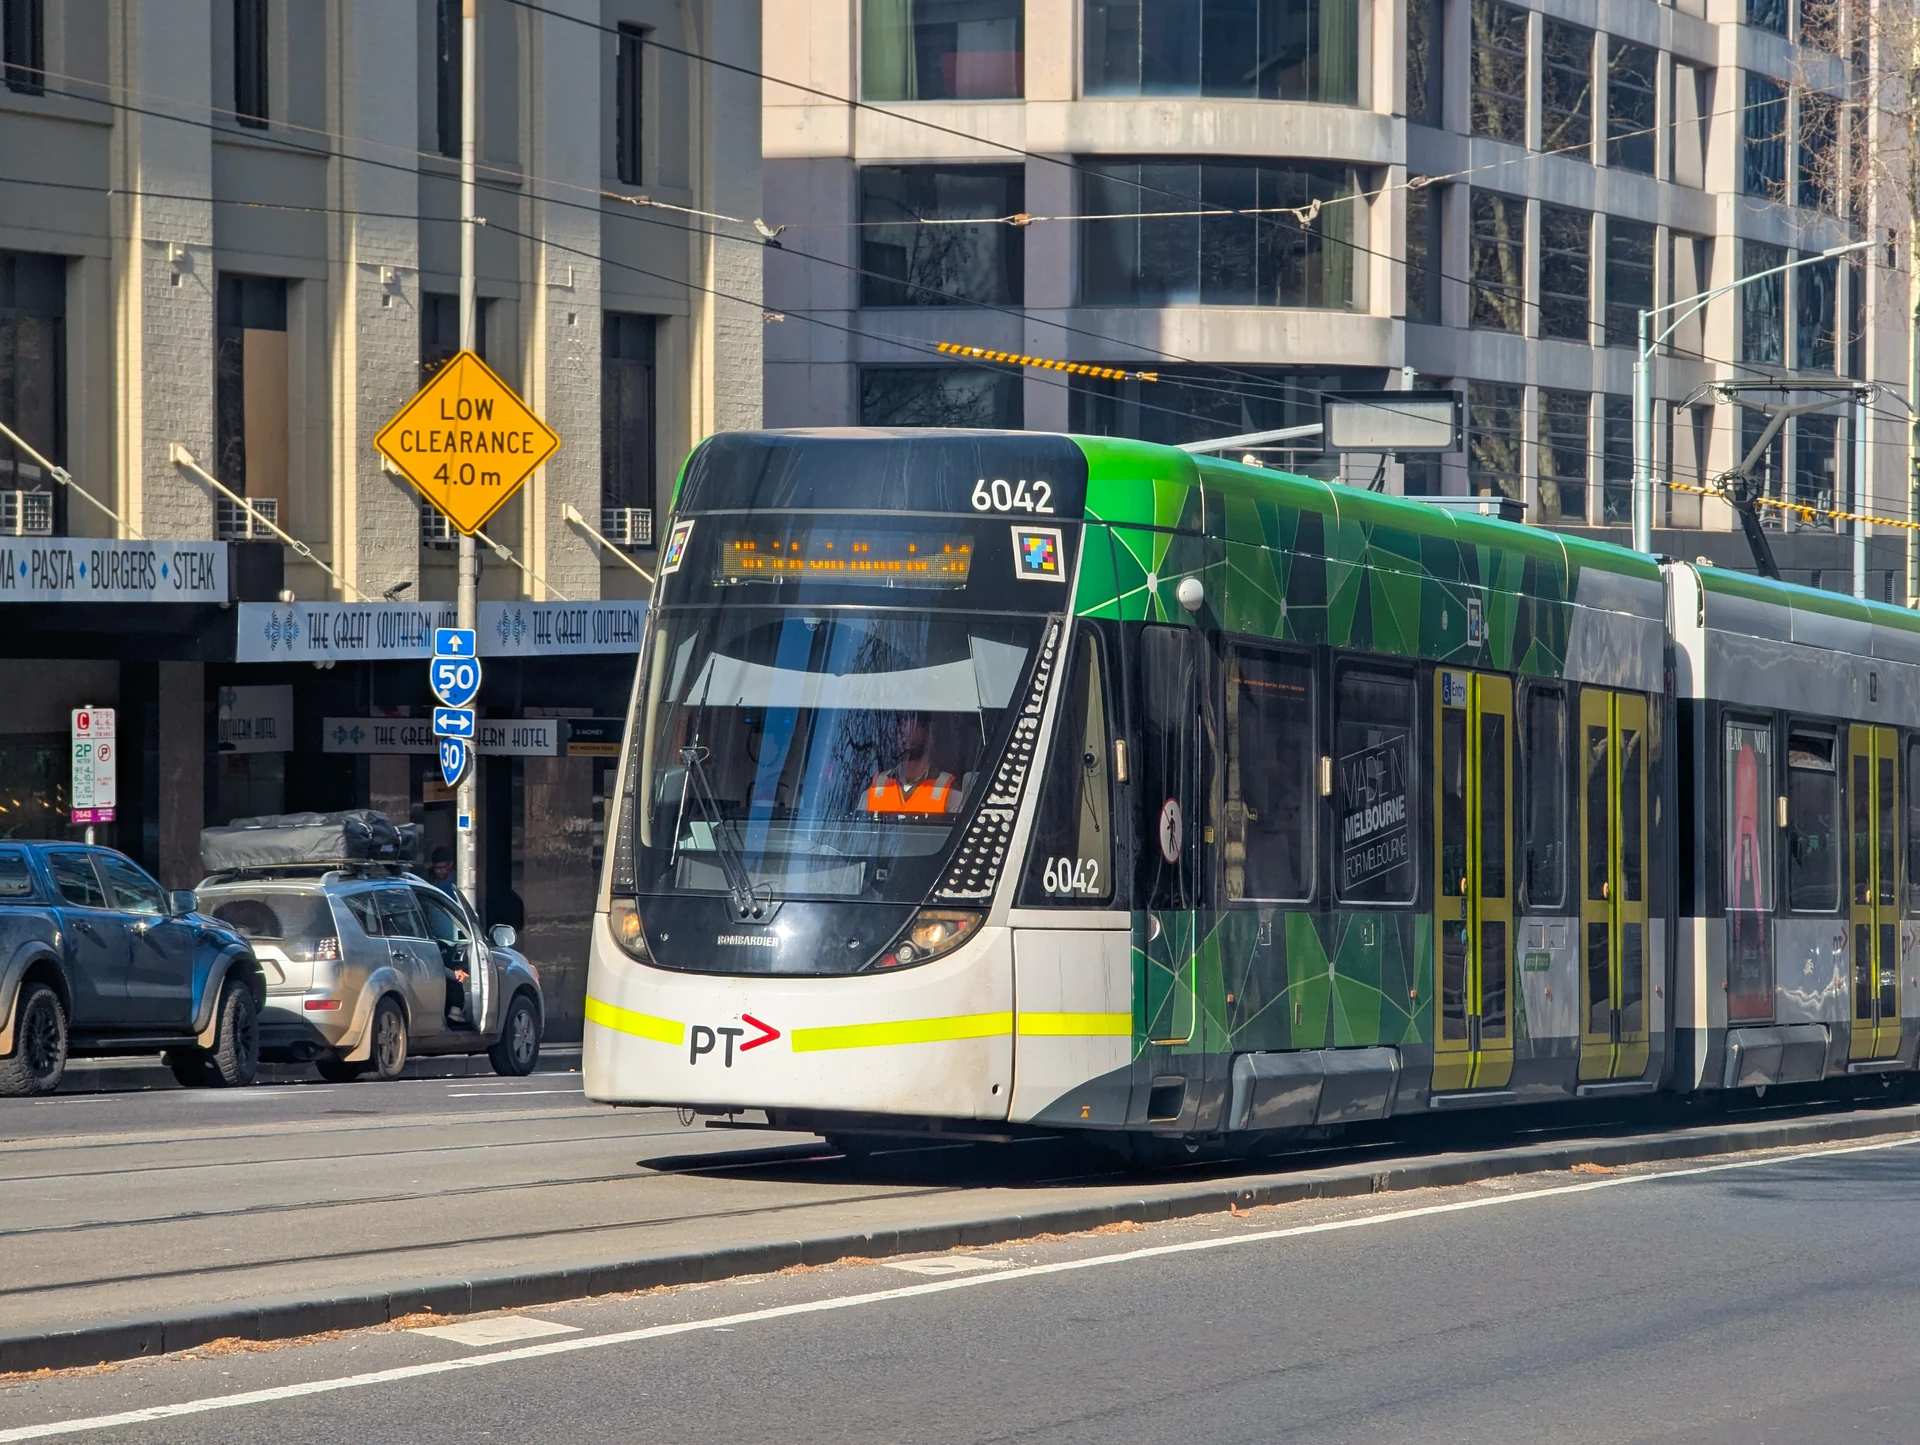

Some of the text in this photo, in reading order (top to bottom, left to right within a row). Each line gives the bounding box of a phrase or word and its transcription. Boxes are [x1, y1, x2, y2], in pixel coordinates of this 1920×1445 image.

[441, 398, 494, 421] LOW
[400, 430, 534, 454] CLEARANCE
[971, 479, 1055, 513] 6042
[32, 549, 75, 589] PASTA
[91, 551, 156, 590] BURGERS
[173, 552, 215, 590] STEAK
[308, 612, 329, 649] THE
[334, 612, 372, 649] GREAT
[377, 611, 431, 648] SOUTHERN
[533, 609, 639, 645] THE GREAT SOUTHERN
[439, 664, 474, 690] 50
[1452, 681, 1466, 702] Entry
[373, 726, 396, 745] THE
[511, 727, 549, 748] HOTEL
[1754, 730, 1767, 754] NOT
[75, 744, 92, 758] 2P
[443, 742, 460, 769] 30
[1342, 743, 1405, 809] MADE IN
[1344, 794, 1406, 843] MELBOURNE
[1346, 834, 1407, 880] FOR MELBOURNE
[1043, 857, 1099, 894] 6042
[717, 935, 779, 947] BOMBARDIER
